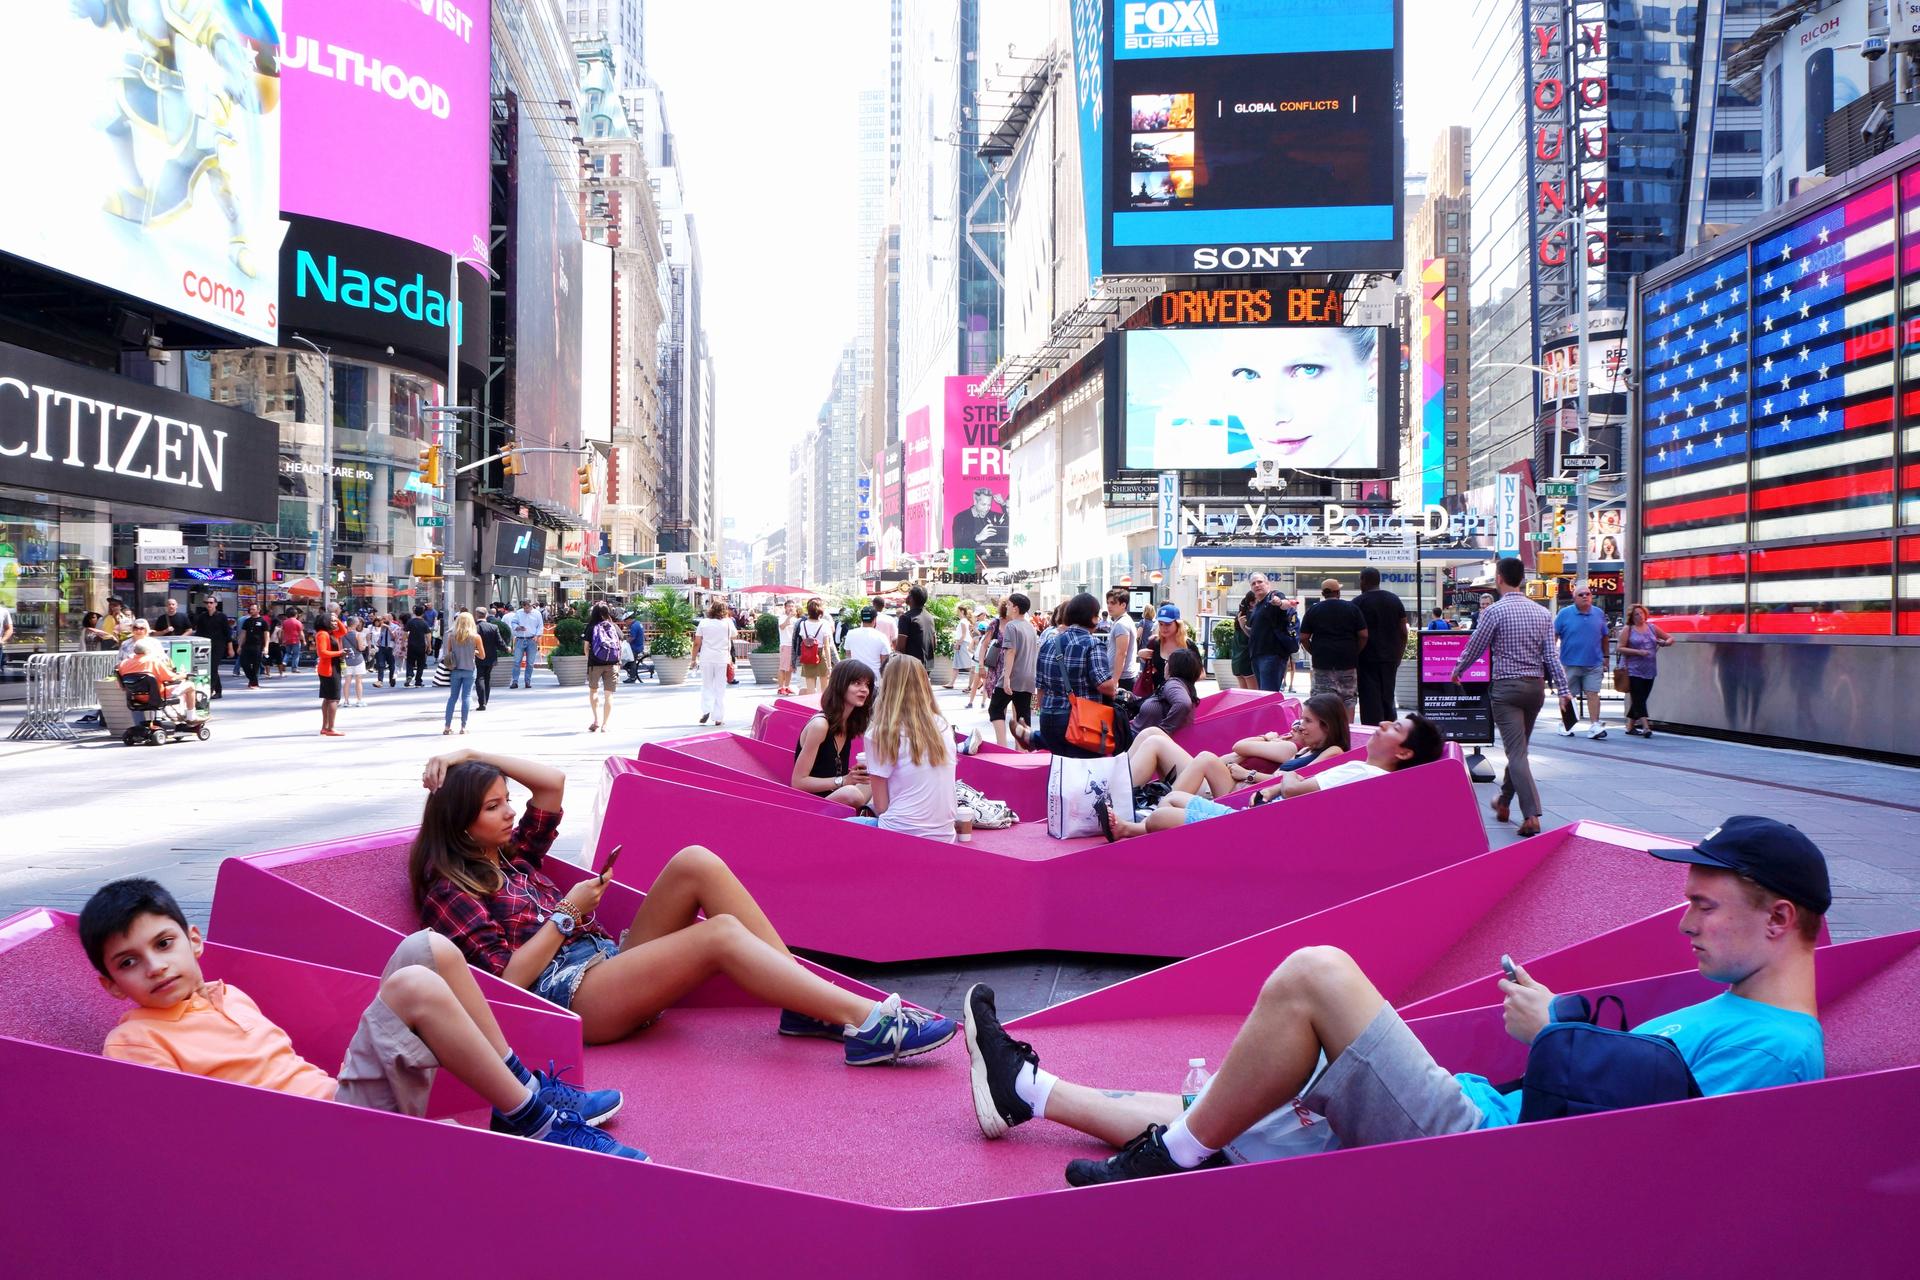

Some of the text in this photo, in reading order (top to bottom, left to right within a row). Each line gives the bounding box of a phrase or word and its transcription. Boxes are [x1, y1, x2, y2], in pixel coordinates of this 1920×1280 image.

[1125, 0, 1208, 33] FOX
[1125, 33, 1219, 49] BUSINESS
[1801, 17, 1840, 46] RICOH
[1234, 100, 1339, 114] GLOBAL CONFLICTS
[1535, 25, 1567, 266] YOUNG
[1193, 246, 1312, 269] SONY
[1106, 284, 1161, 295] SHERWOOD
[1162, 288, 1272, 325] DRIVERS
[0, 376, 228, 492] CITIZEN
[286, 462, 373, 480] HEALTCARE IPOs
[1111, 484, 1156, 493] SHERWOOD
[1547, 485, 1554, 494] W
[1557, 485, 1567, 494] 43
[418, 518, 424, 526] W
[427, 517, 436, 526] 43
[1164, 478, 1174, 546] NYPD
[1182, 503, 1239, 536] NEW
[1244, 503, 1313, 536] YORK
[1424, 504, 1495, 537] DEPT
[1505, 477, 1515, 547] NYPD
[11, 612, 33, 625] ATCH
